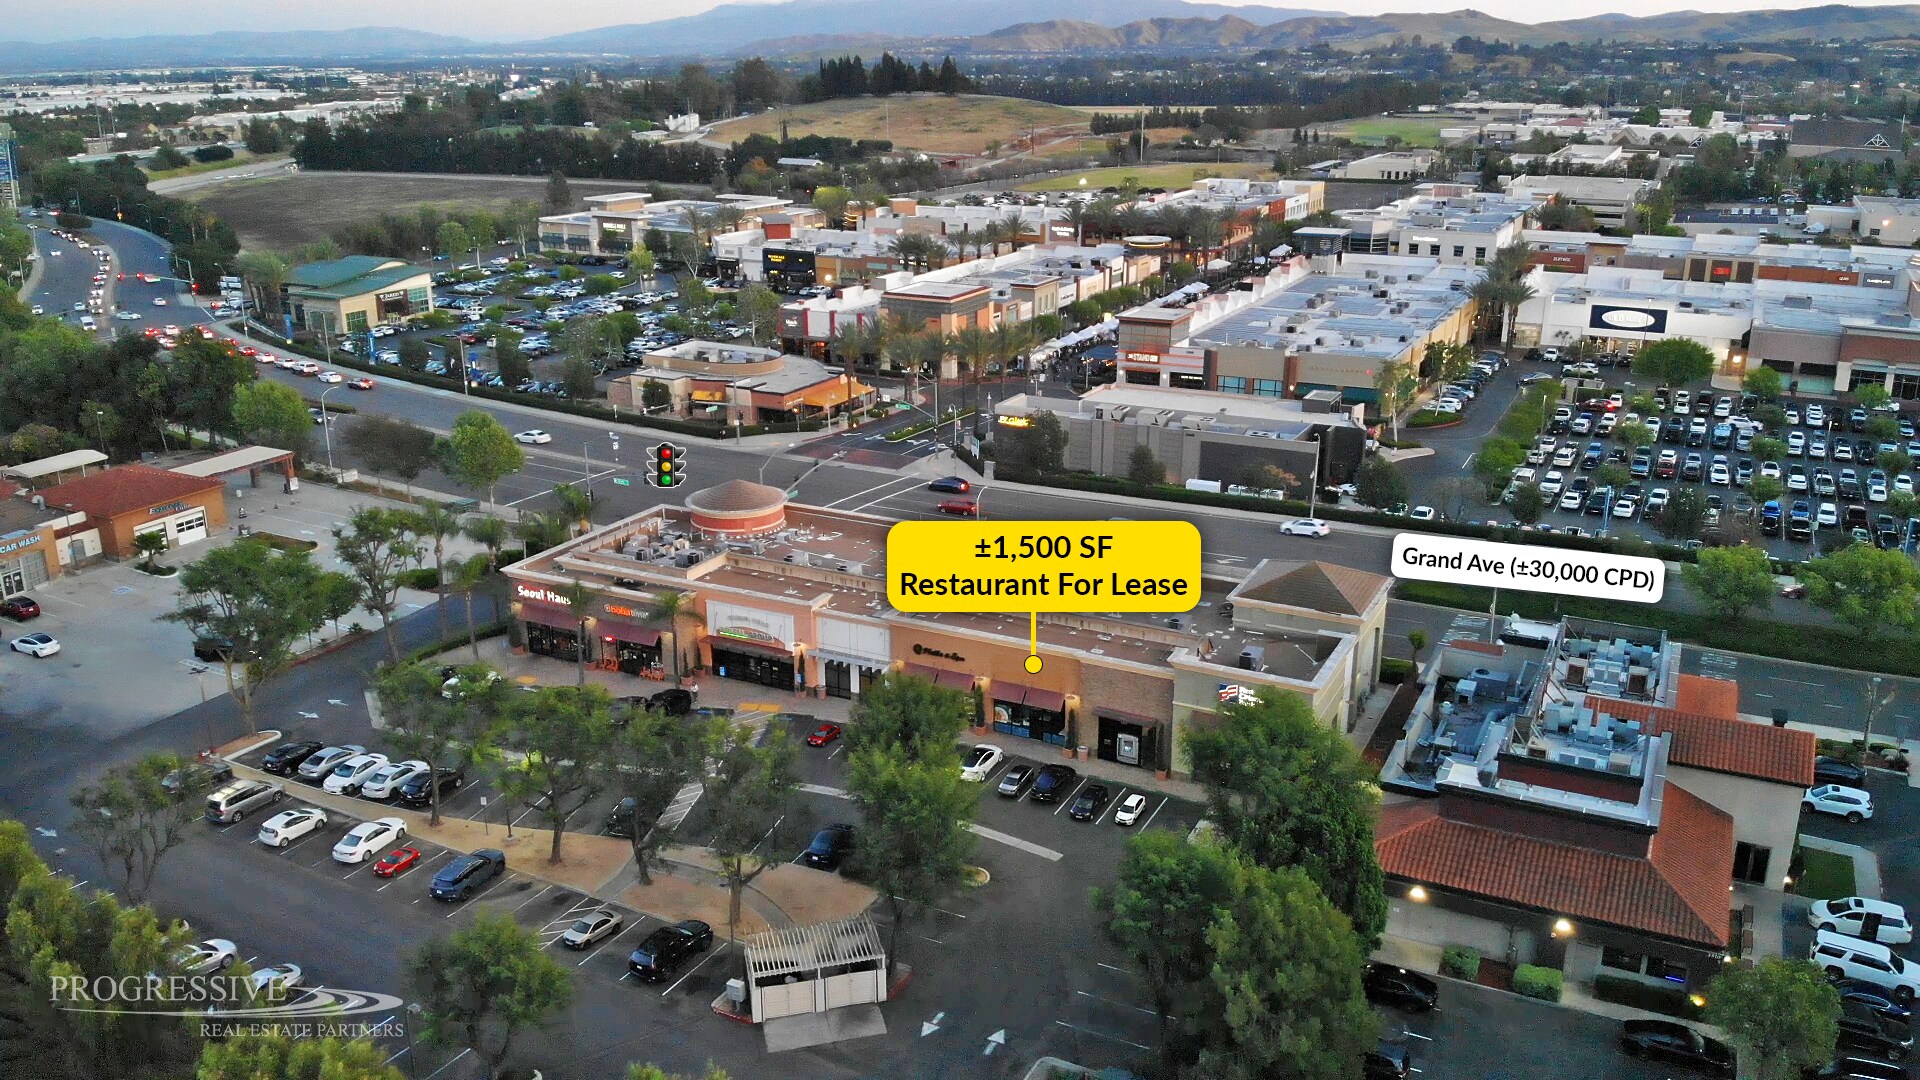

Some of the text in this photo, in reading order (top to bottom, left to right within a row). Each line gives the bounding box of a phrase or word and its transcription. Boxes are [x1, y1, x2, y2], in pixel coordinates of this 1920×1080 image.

[0, 535, 40, 554] CAR WASH
[517, 585, 545, 600] Seoul
